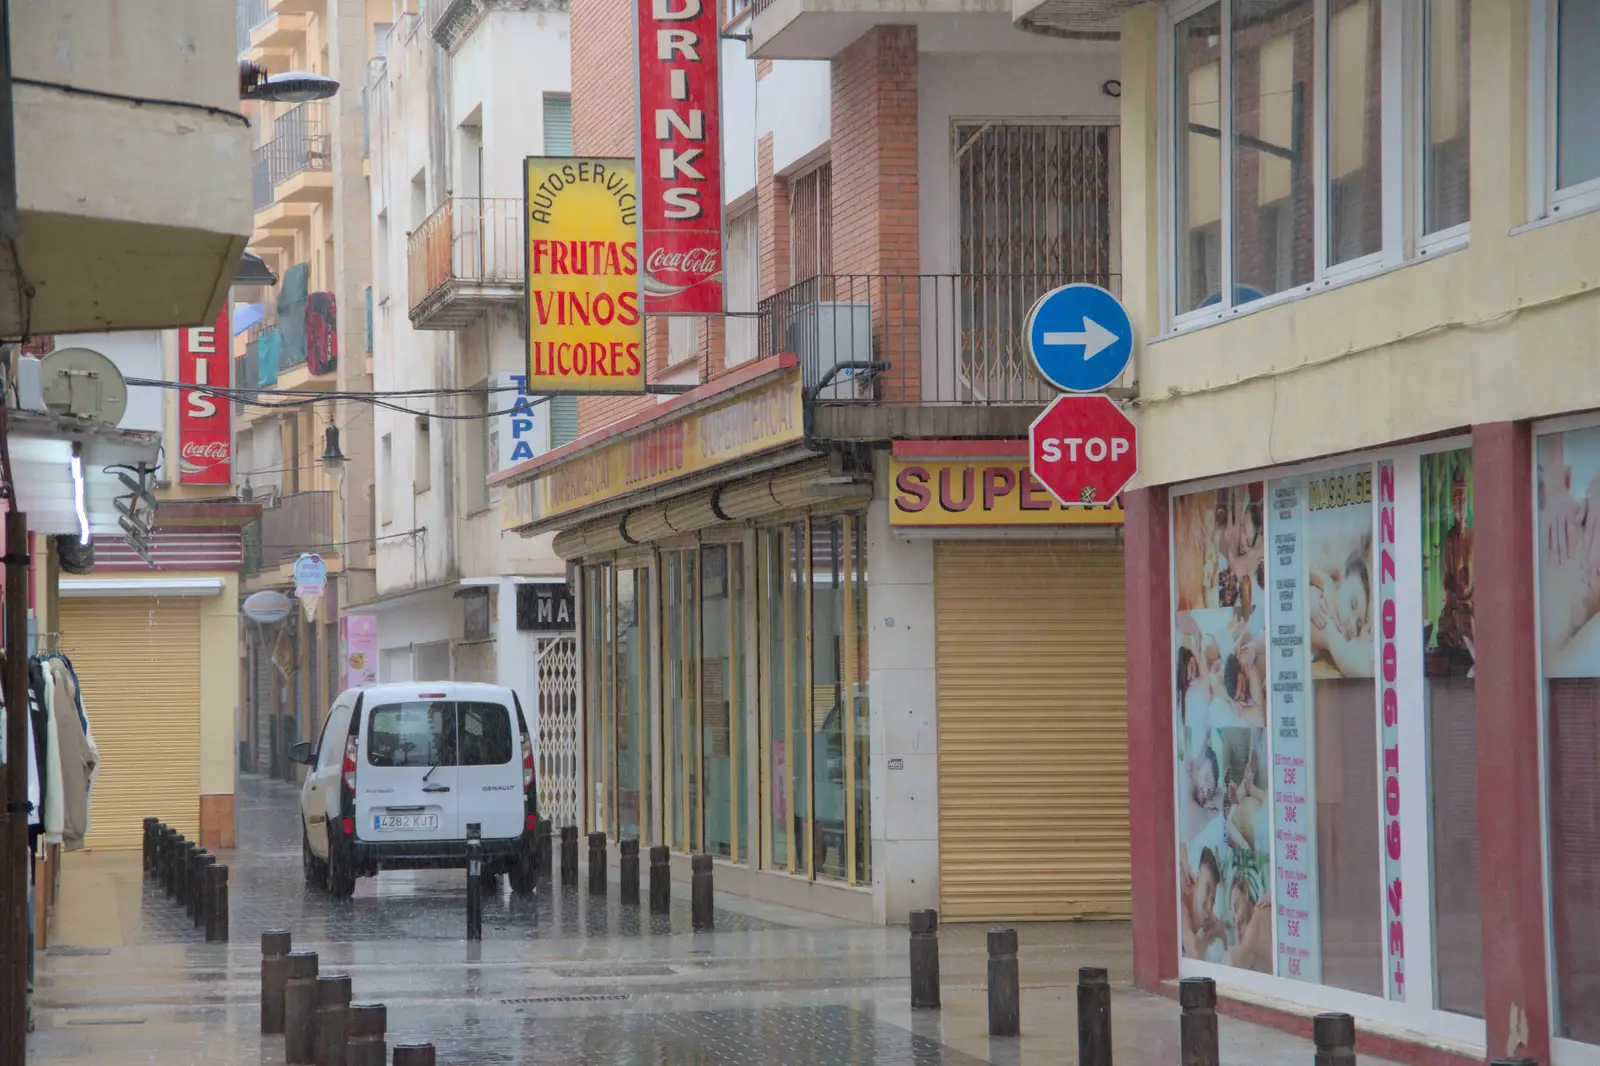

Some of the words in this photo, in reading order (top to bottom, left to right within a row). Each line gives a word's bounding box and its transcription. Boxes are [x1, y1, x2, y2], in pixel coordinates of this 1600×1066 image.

[653, 0, 708, 220] DRINKS
[532, 239, 638, 276] FRUTAS
[646, 247, 720, 273] Coca-Cola
[532, 290, 641, 326] VINOS
[533, 341, 642, 377] LICORES
[181, 441, 230, 459] Coca-Cola
[1041, 437, 1130, 463] STOP
[1309, 471, 1372, 512] MASSAGE
[1380, 464, 1396, 585] 722
[1381, 598, 1398, 728] 900
[1283, 768, 1296, 784] 25€
[1284, 806, 1297, 822] 30€
[1385, 743, 1401, 861] 601
[381, 816, 411, 827] 4282
[412, 816, 434, 826] KJT
